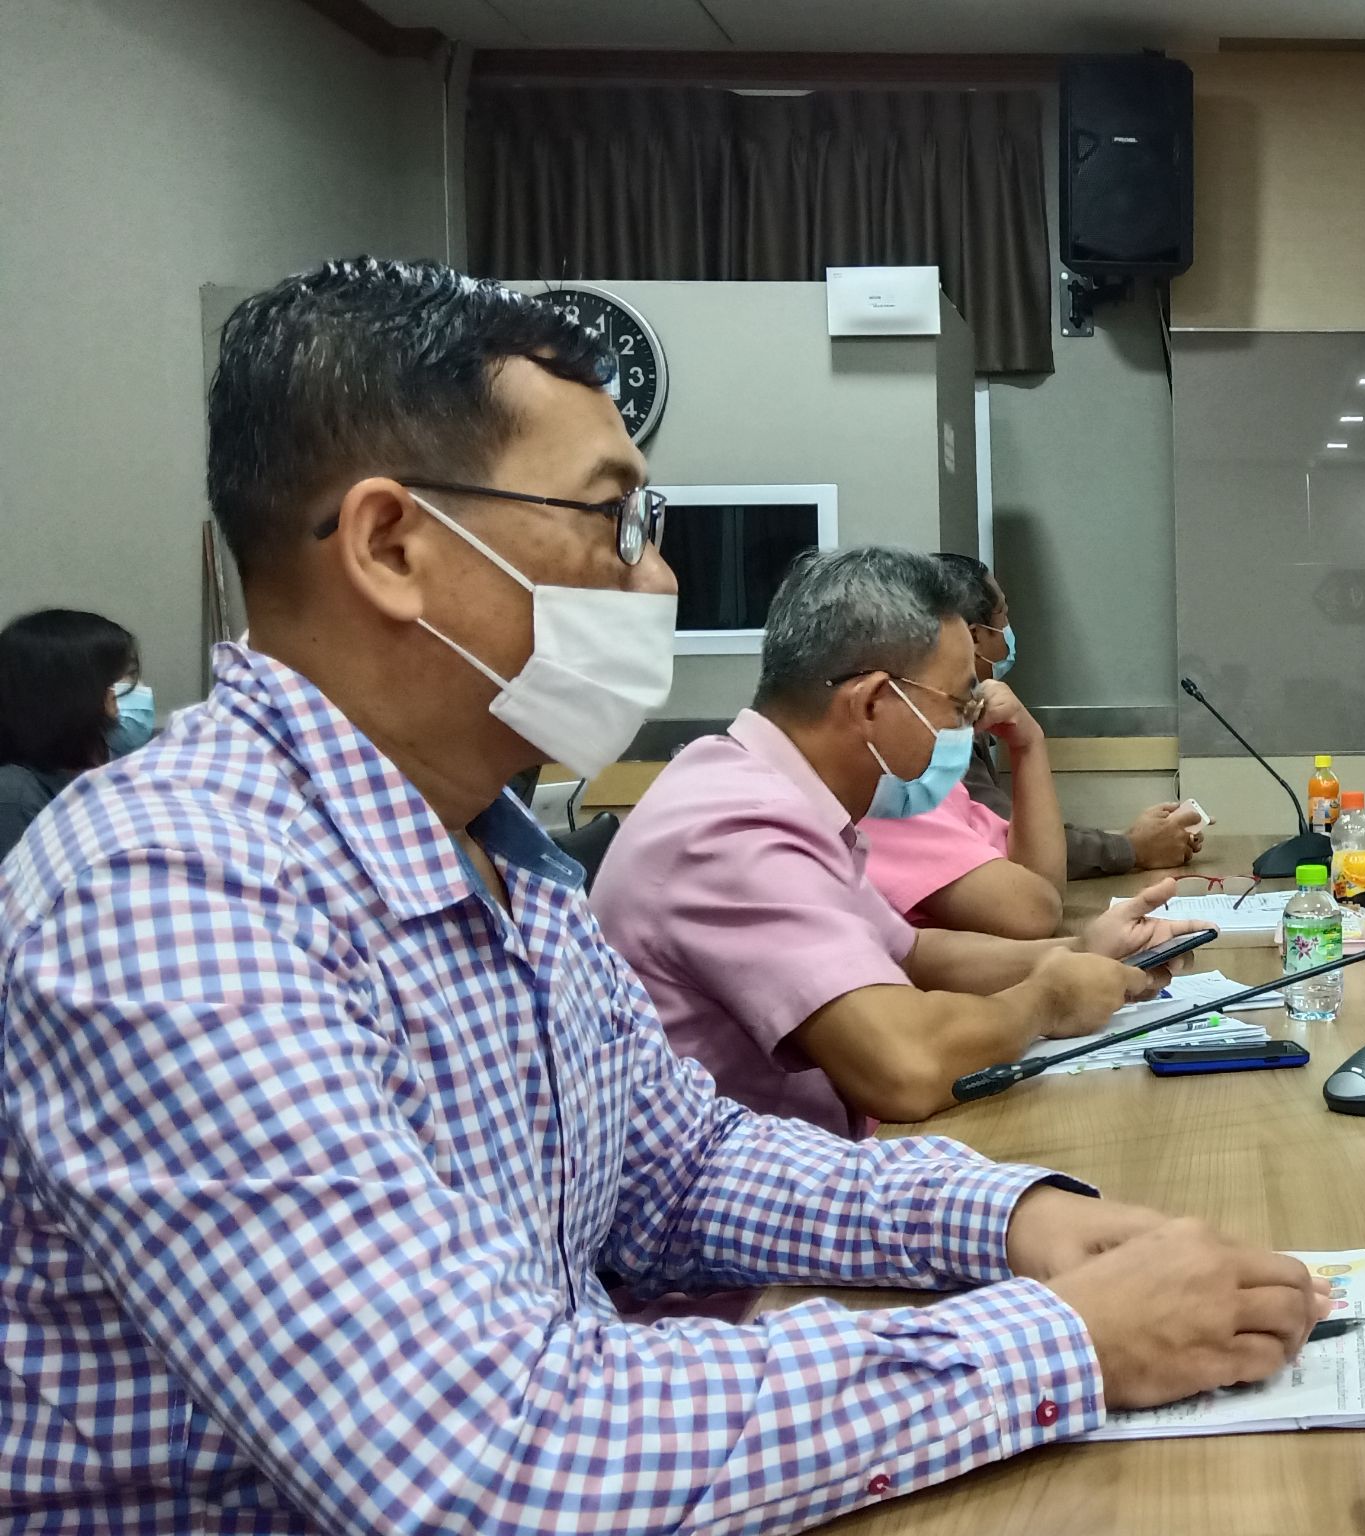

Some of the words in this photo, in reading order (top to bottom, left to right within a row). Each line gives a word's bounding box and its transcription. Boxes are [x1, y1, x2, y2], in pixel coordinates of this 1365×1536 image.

[618, 334, 635, 355] 2
[628, 366, 645, 387] 3
[620, 399, 638, 418] 4
